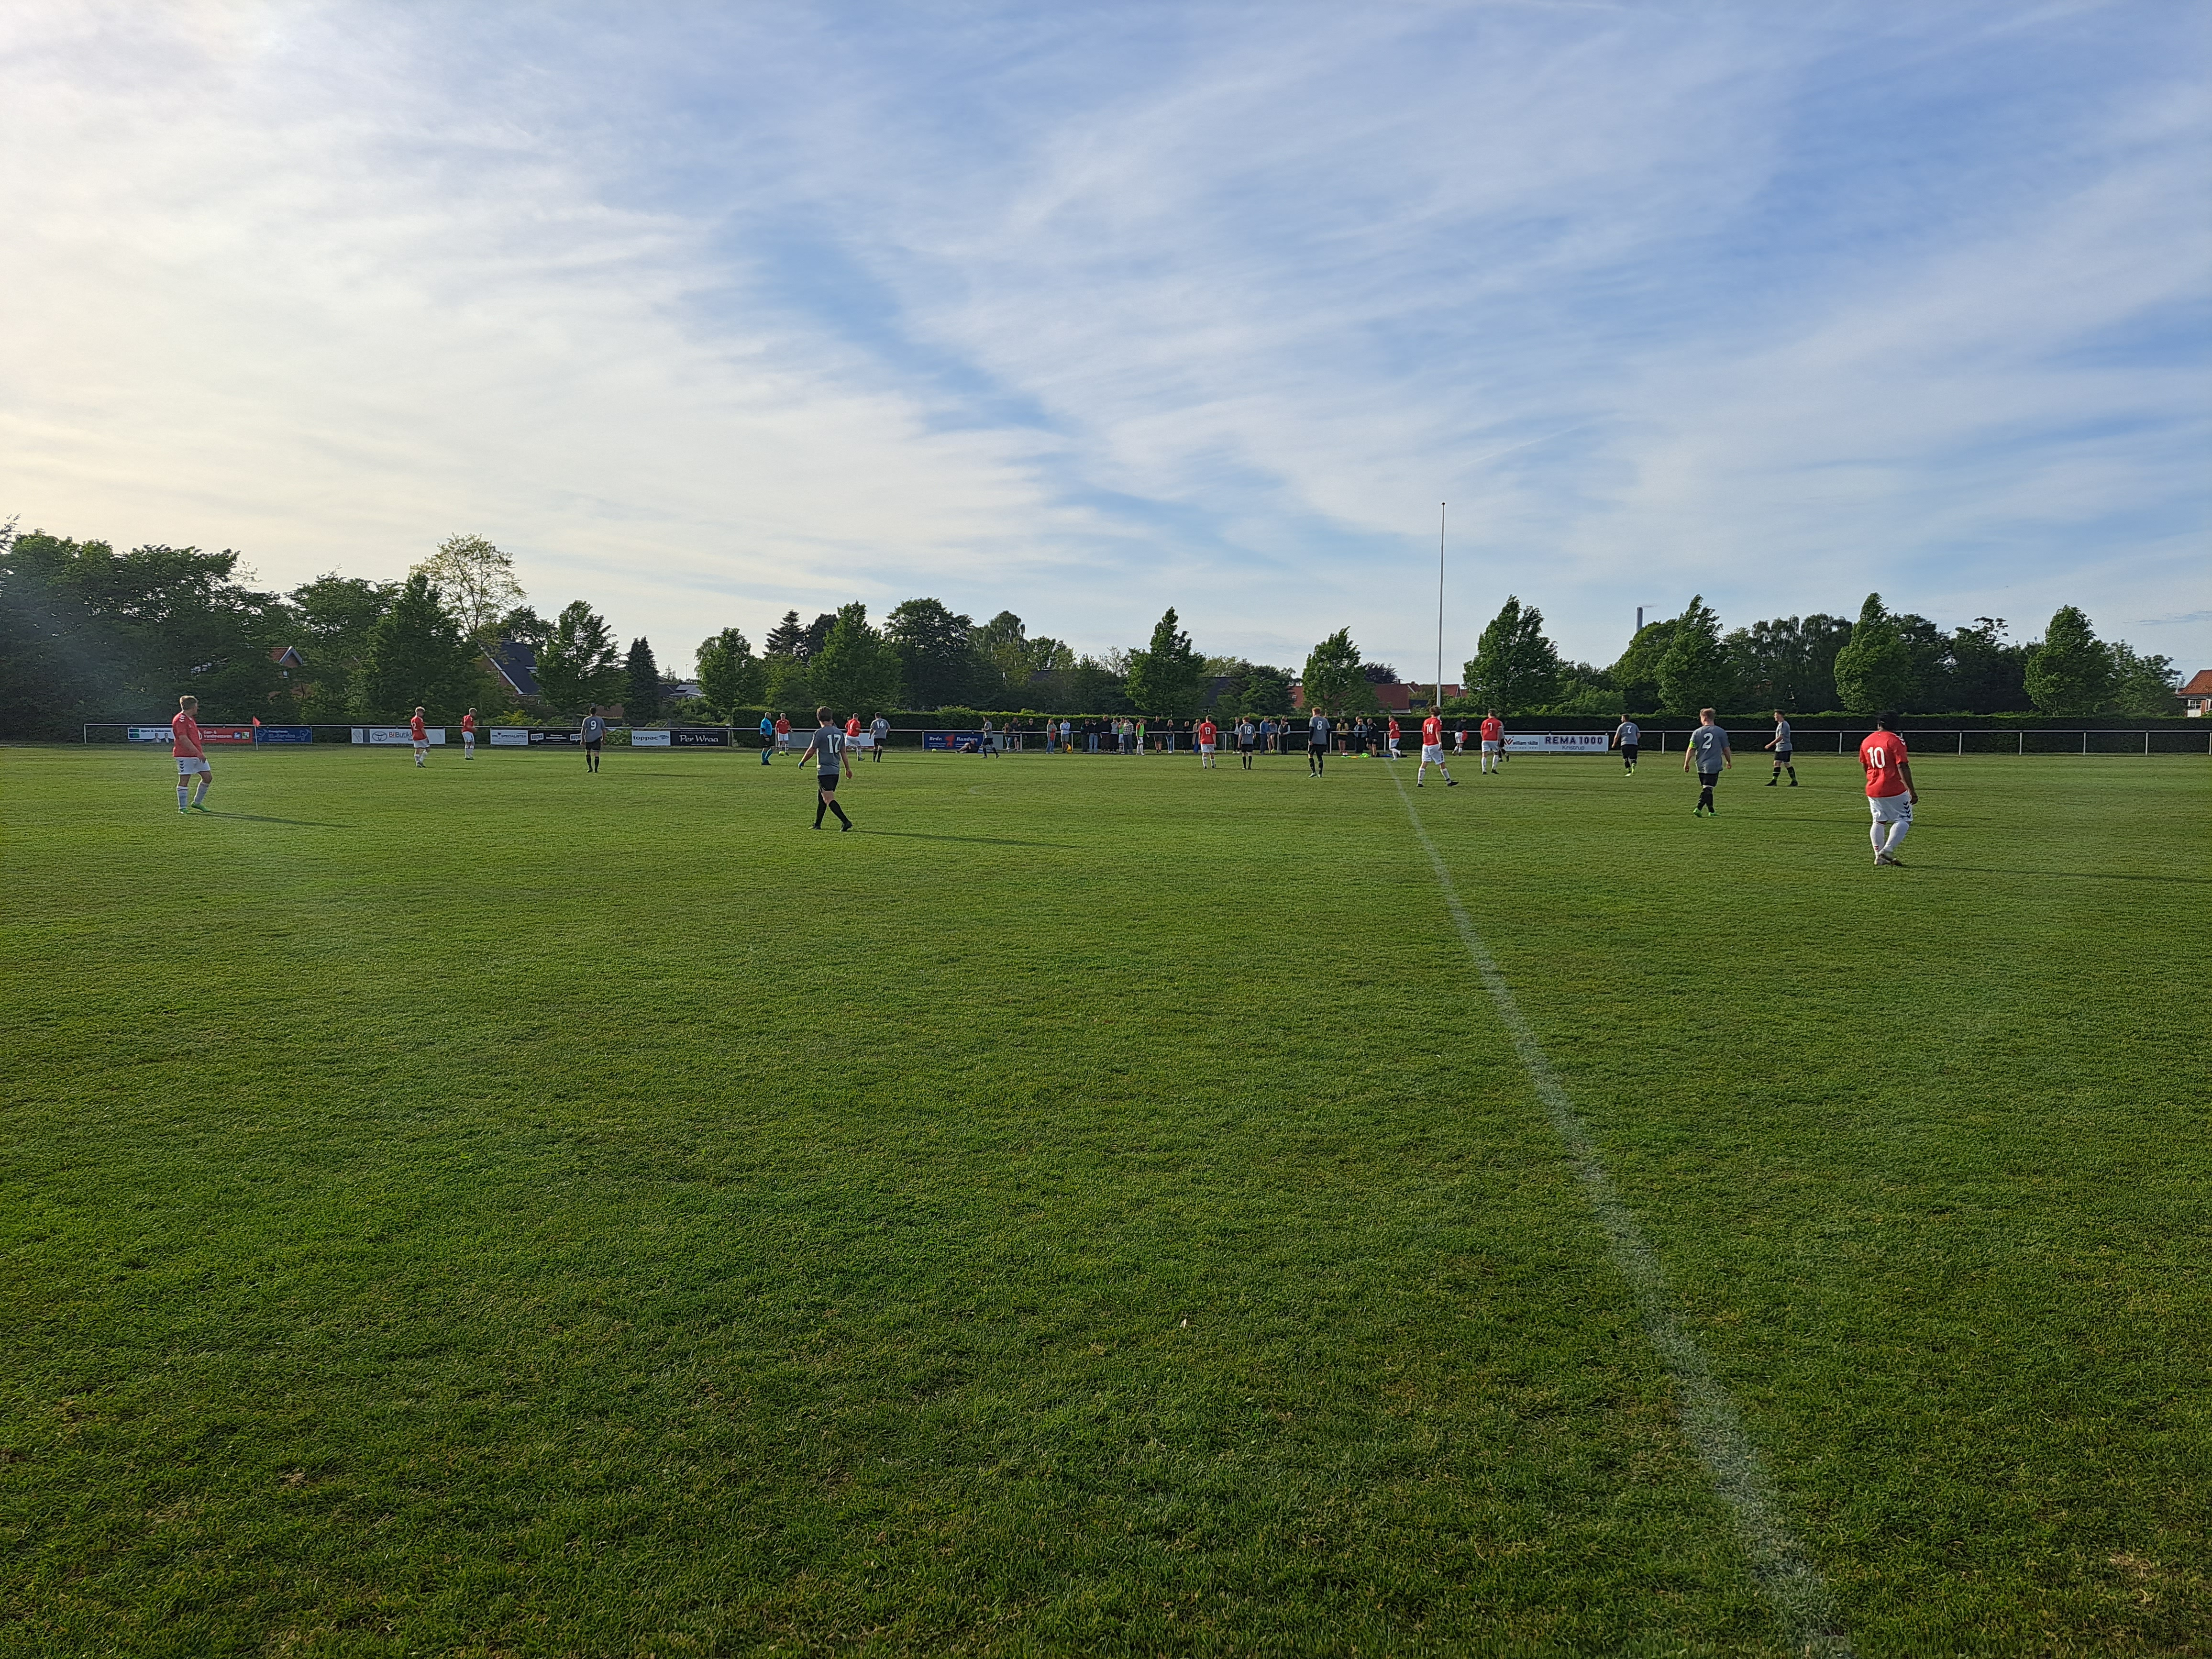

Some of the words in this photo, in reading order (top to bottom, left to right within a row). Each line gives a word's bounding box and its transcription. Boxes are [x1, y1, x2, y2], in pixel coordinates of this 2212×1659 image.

[590, 720, 597, 730] 9
[877, 720, 885, 729] 14
[1316, 720, 1323, 730] 8
[1426, 724, 1434, 734] 14
[1488, 722, 1493, 731] 7
[1205, 727, 1211, 735] 13
[1244, 726, 1252, 734] 18
[1626, 725, 1632, 734] 7
[827, 734, 841, 753] 17
[1545, 736, 1577, 745] REMA
[1579, 736, 1603, 745] 1000
[1702, 733, 1714, 749] 2
[1867, 747, 1885, 768] 10
